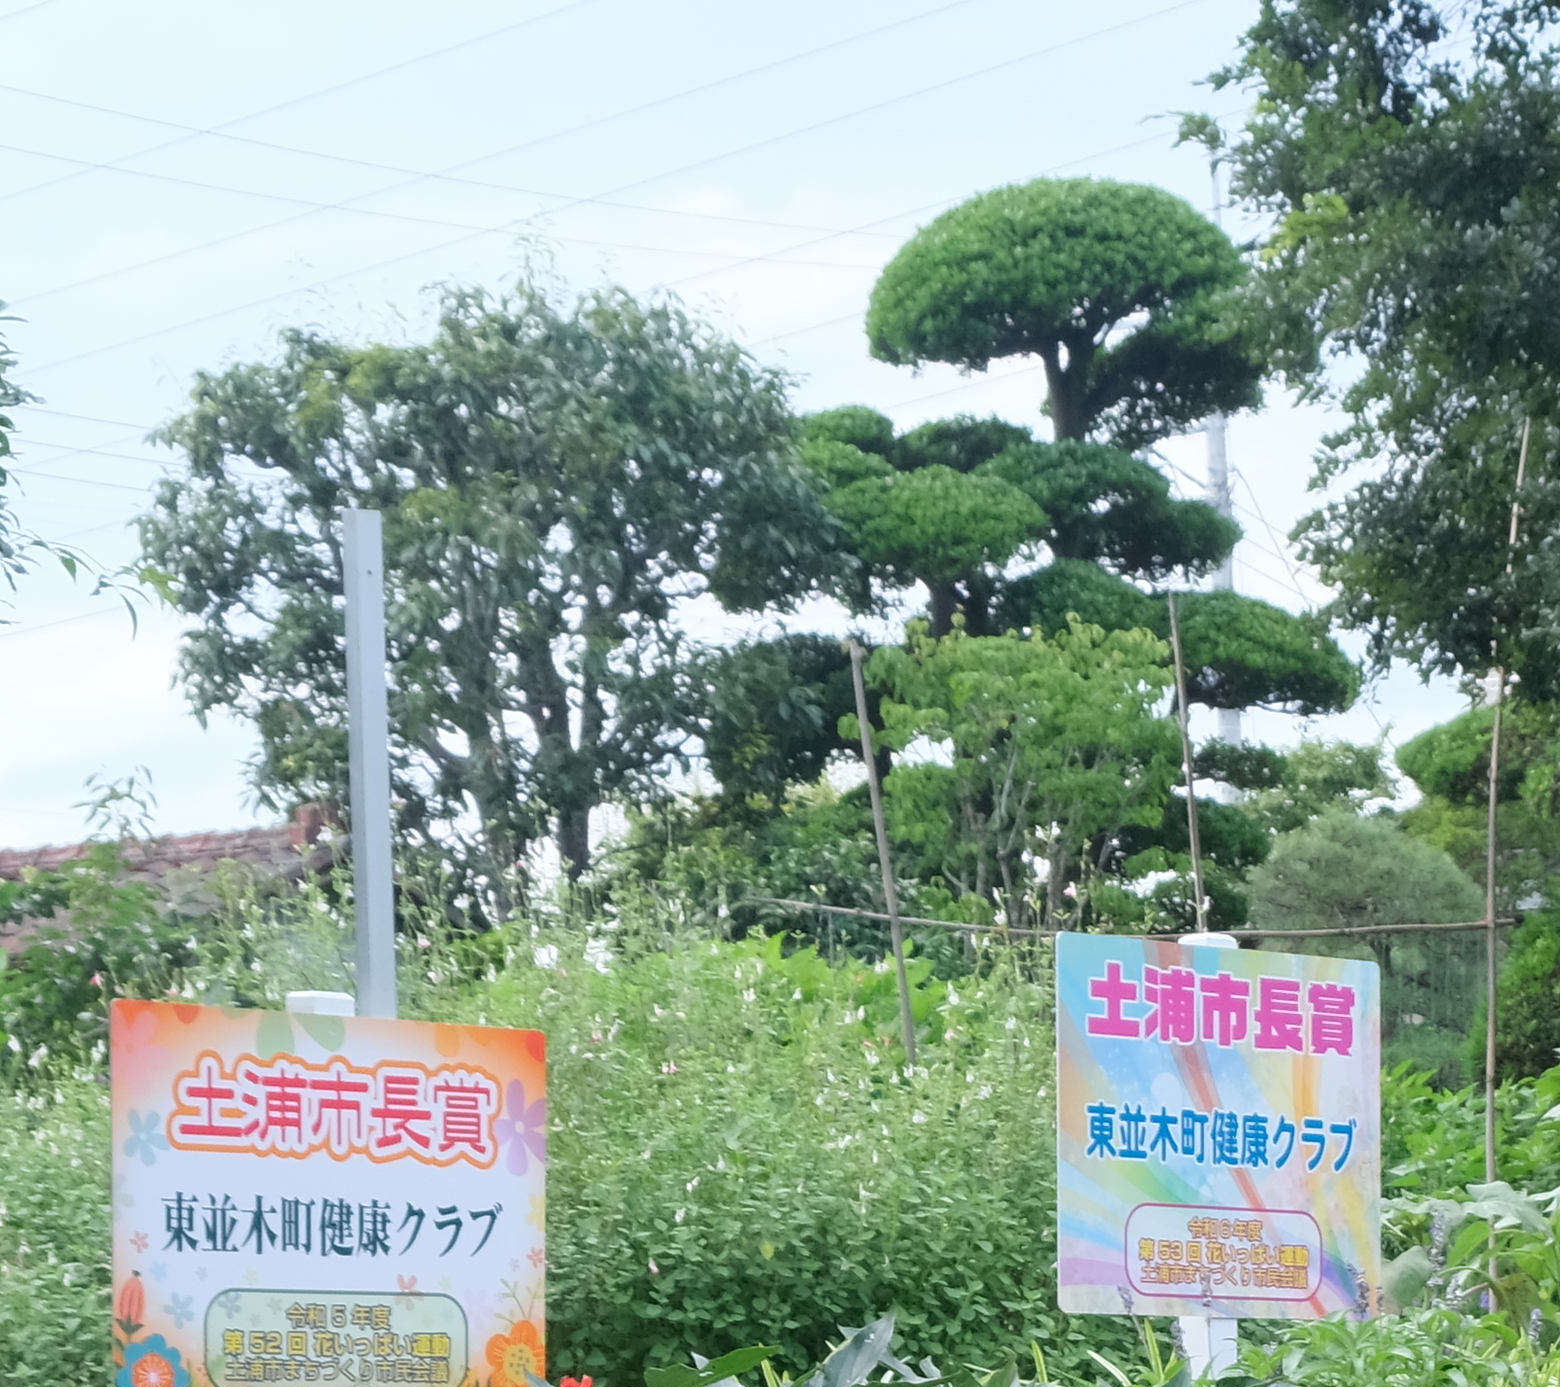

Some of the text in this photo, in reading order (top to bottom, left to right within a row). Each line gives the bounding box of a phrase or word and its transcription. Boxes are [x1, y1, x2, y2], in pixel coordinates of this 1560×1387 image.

[1087, 962, 1356, 1057] 土浦市長賞
[178, 1064, 492, 1155] 土浦市長賞
[1085, 1102, 1358, 1172] 東並木町健康クラブ
[161, 1191, 504, 1258] 東並木町健康クラブ
[1188, 1216, 1263, 1242] 令和6年度
[286, 1302, 391, 1330] 令和5年度
[225, 1356, 449, 1383] 土浦市まちづくり市民会議
